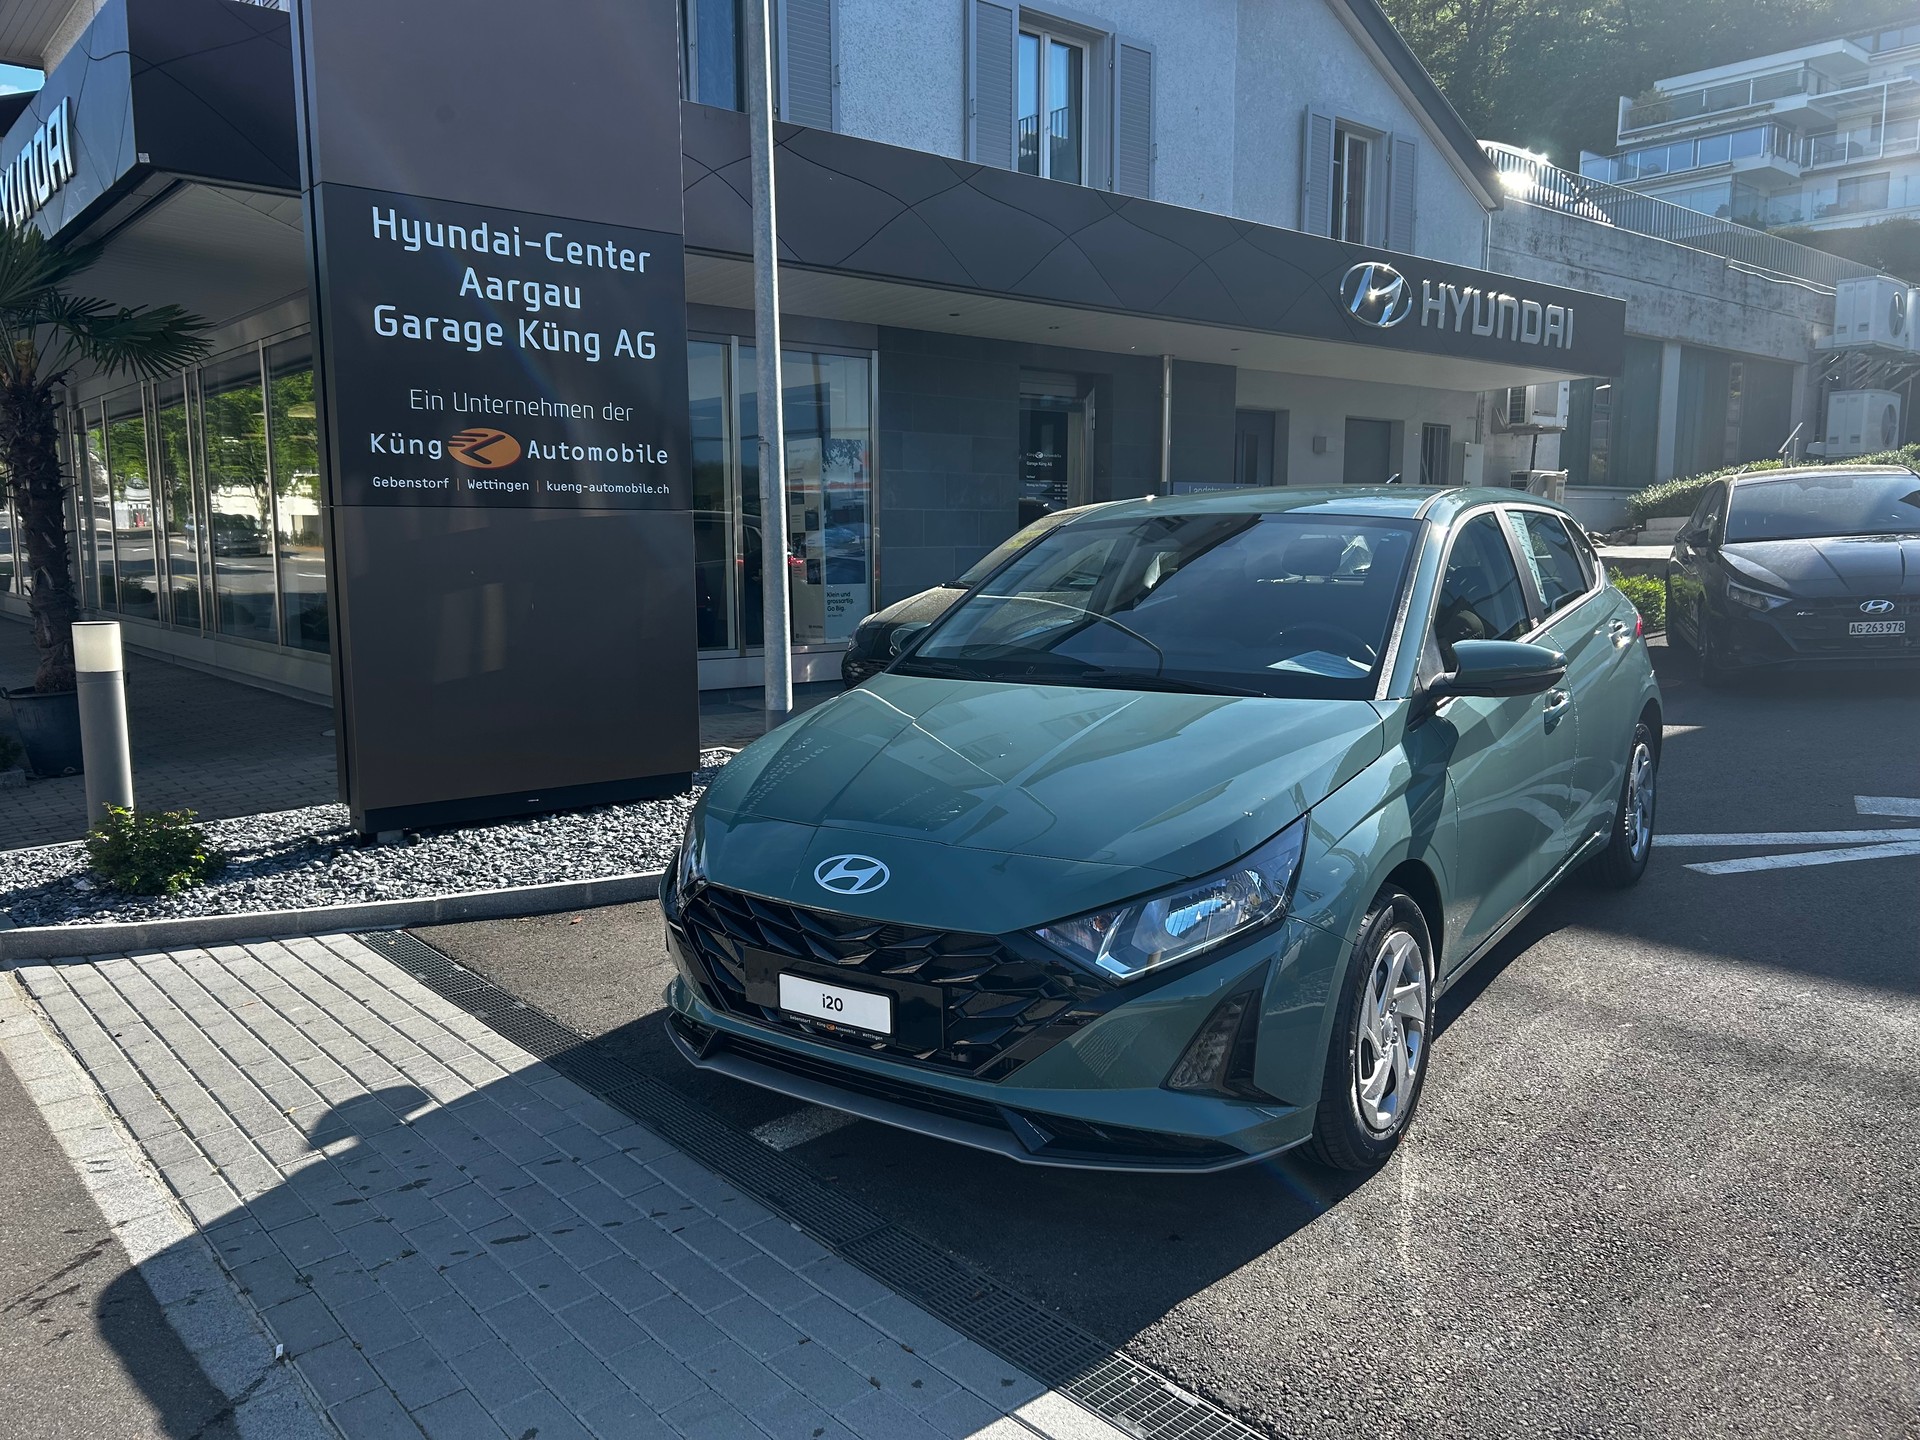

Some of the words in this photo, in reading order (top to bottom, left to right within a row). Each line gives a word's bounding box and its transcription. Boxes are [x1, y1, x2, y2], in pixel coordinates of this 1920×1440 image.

[371, 206, 651, 273] Hyundai-Center
[459, 266, 582, 312] Aargau
[373, 304, 504, 352] Garage
[518, 318, 600, 362] Küng
[613, 328, 656, 359] AG
[1420, 279, 1574, 350] HYUNDAI
[409, 388, 444, 411] Ein
[453, 391, 595, 420] Unternehmen
[602, 401, 634, 422] der
[370, 431, 443, 460] Küng
[527, 439, 669, 464] Automobile
[372, 475, 450, 489] Gebenstorf
[467, 478, 530, 492] Wettingen
[546, 479, 670, 495] kueng-automobile.ch
[821, 993, 844, 1012] i20
